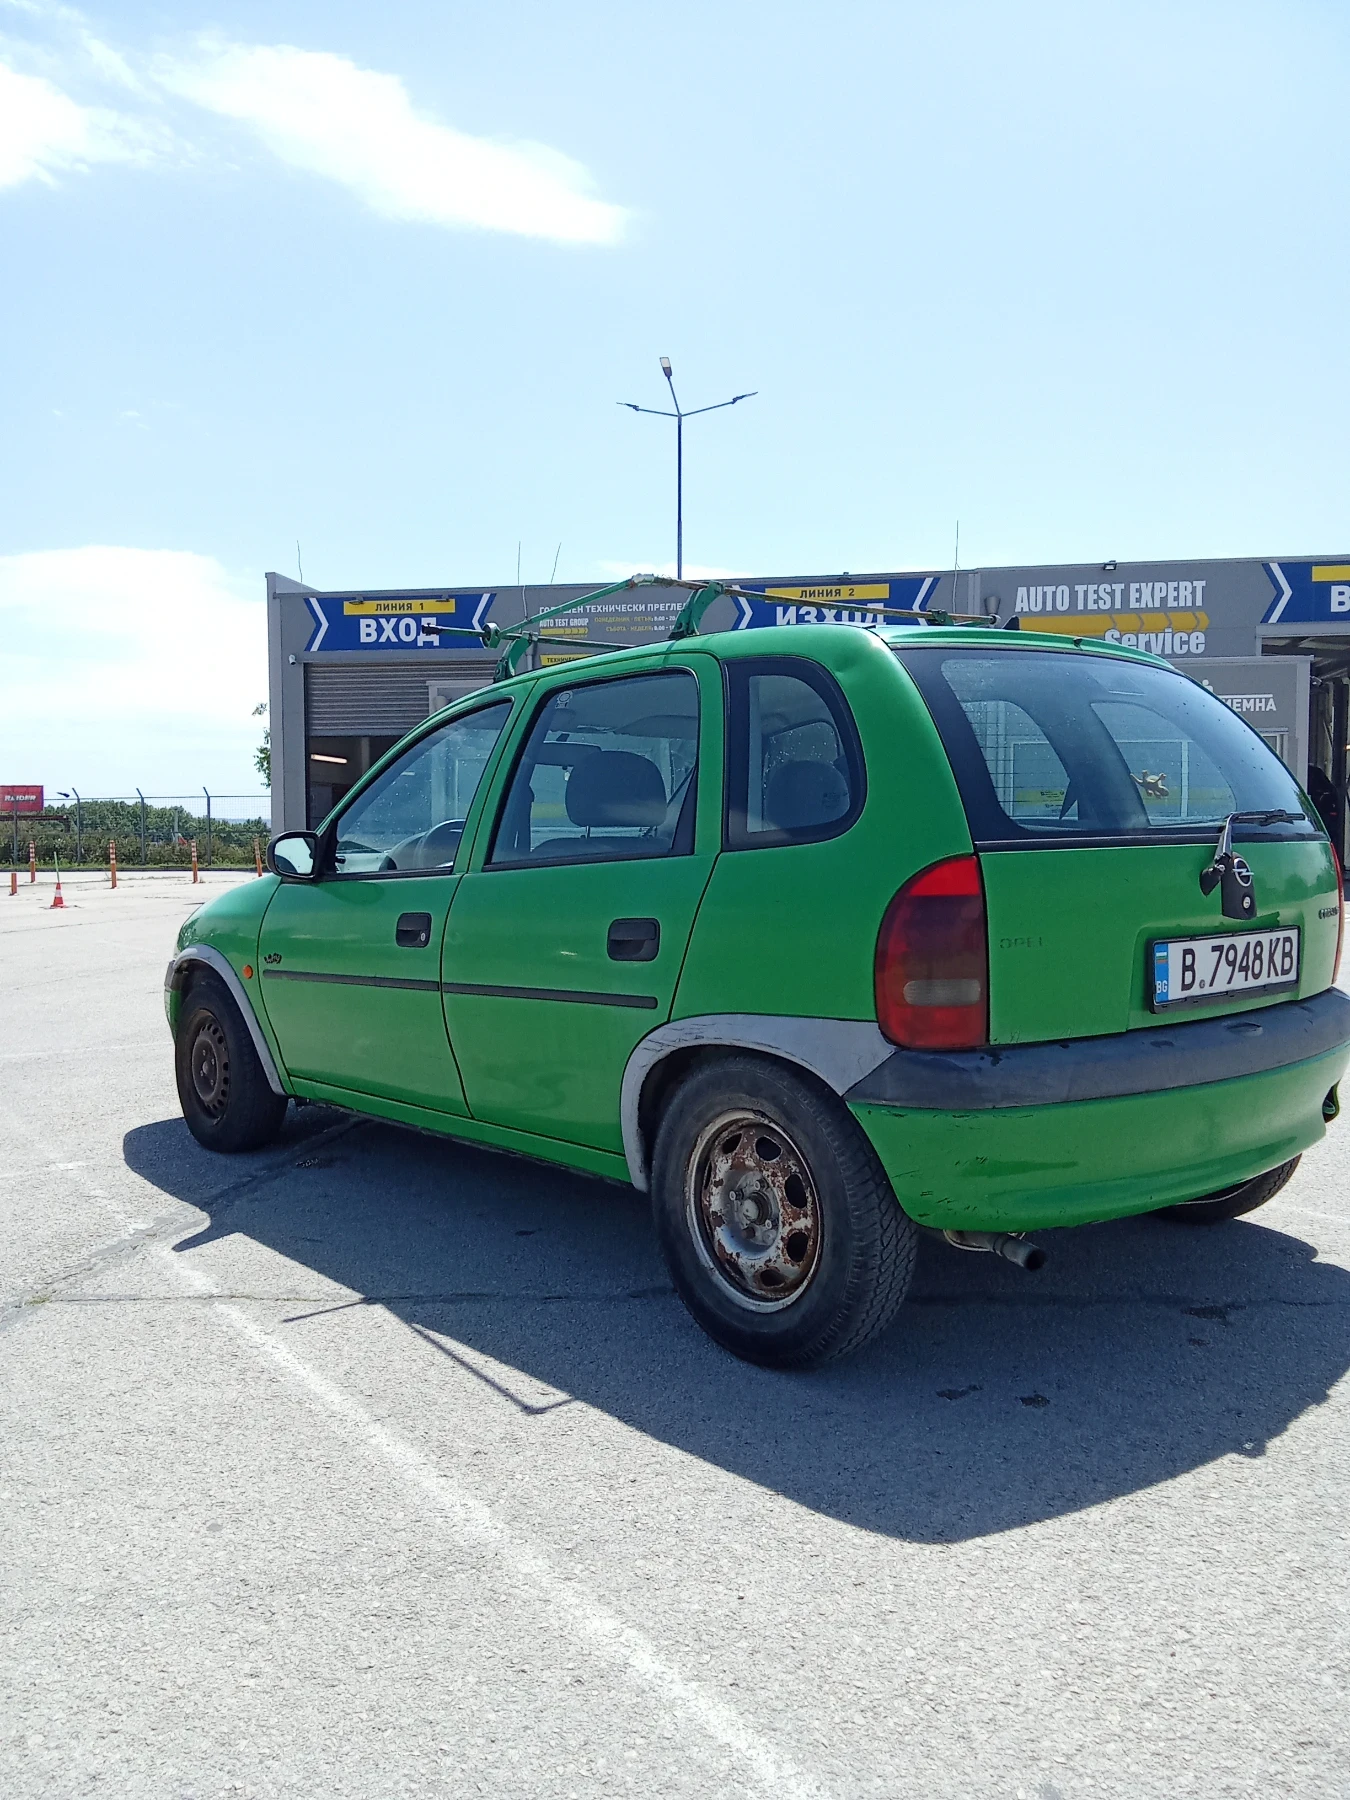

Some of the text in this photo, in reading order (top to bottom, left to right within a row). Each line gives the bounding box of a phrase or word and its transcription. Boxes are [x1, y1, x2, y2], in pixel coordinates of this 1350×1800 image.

[799, 588, 854, 598] ЛИНИЯ 2
[1014, 580, 1206, 613] AUTO TEST EXPERT
[375, 602, 424, 611] ЛИНИЯ 1
[586, 604, 645, 613] ТЕХНИЧЕСКИ
[539, 618, 589, 627] AUTO TEST GROUP
[359, 617, 440, 647] ВХОД
[1104, 627, 1206, 655] Service
[1155, 980, 1169, 994] BG
